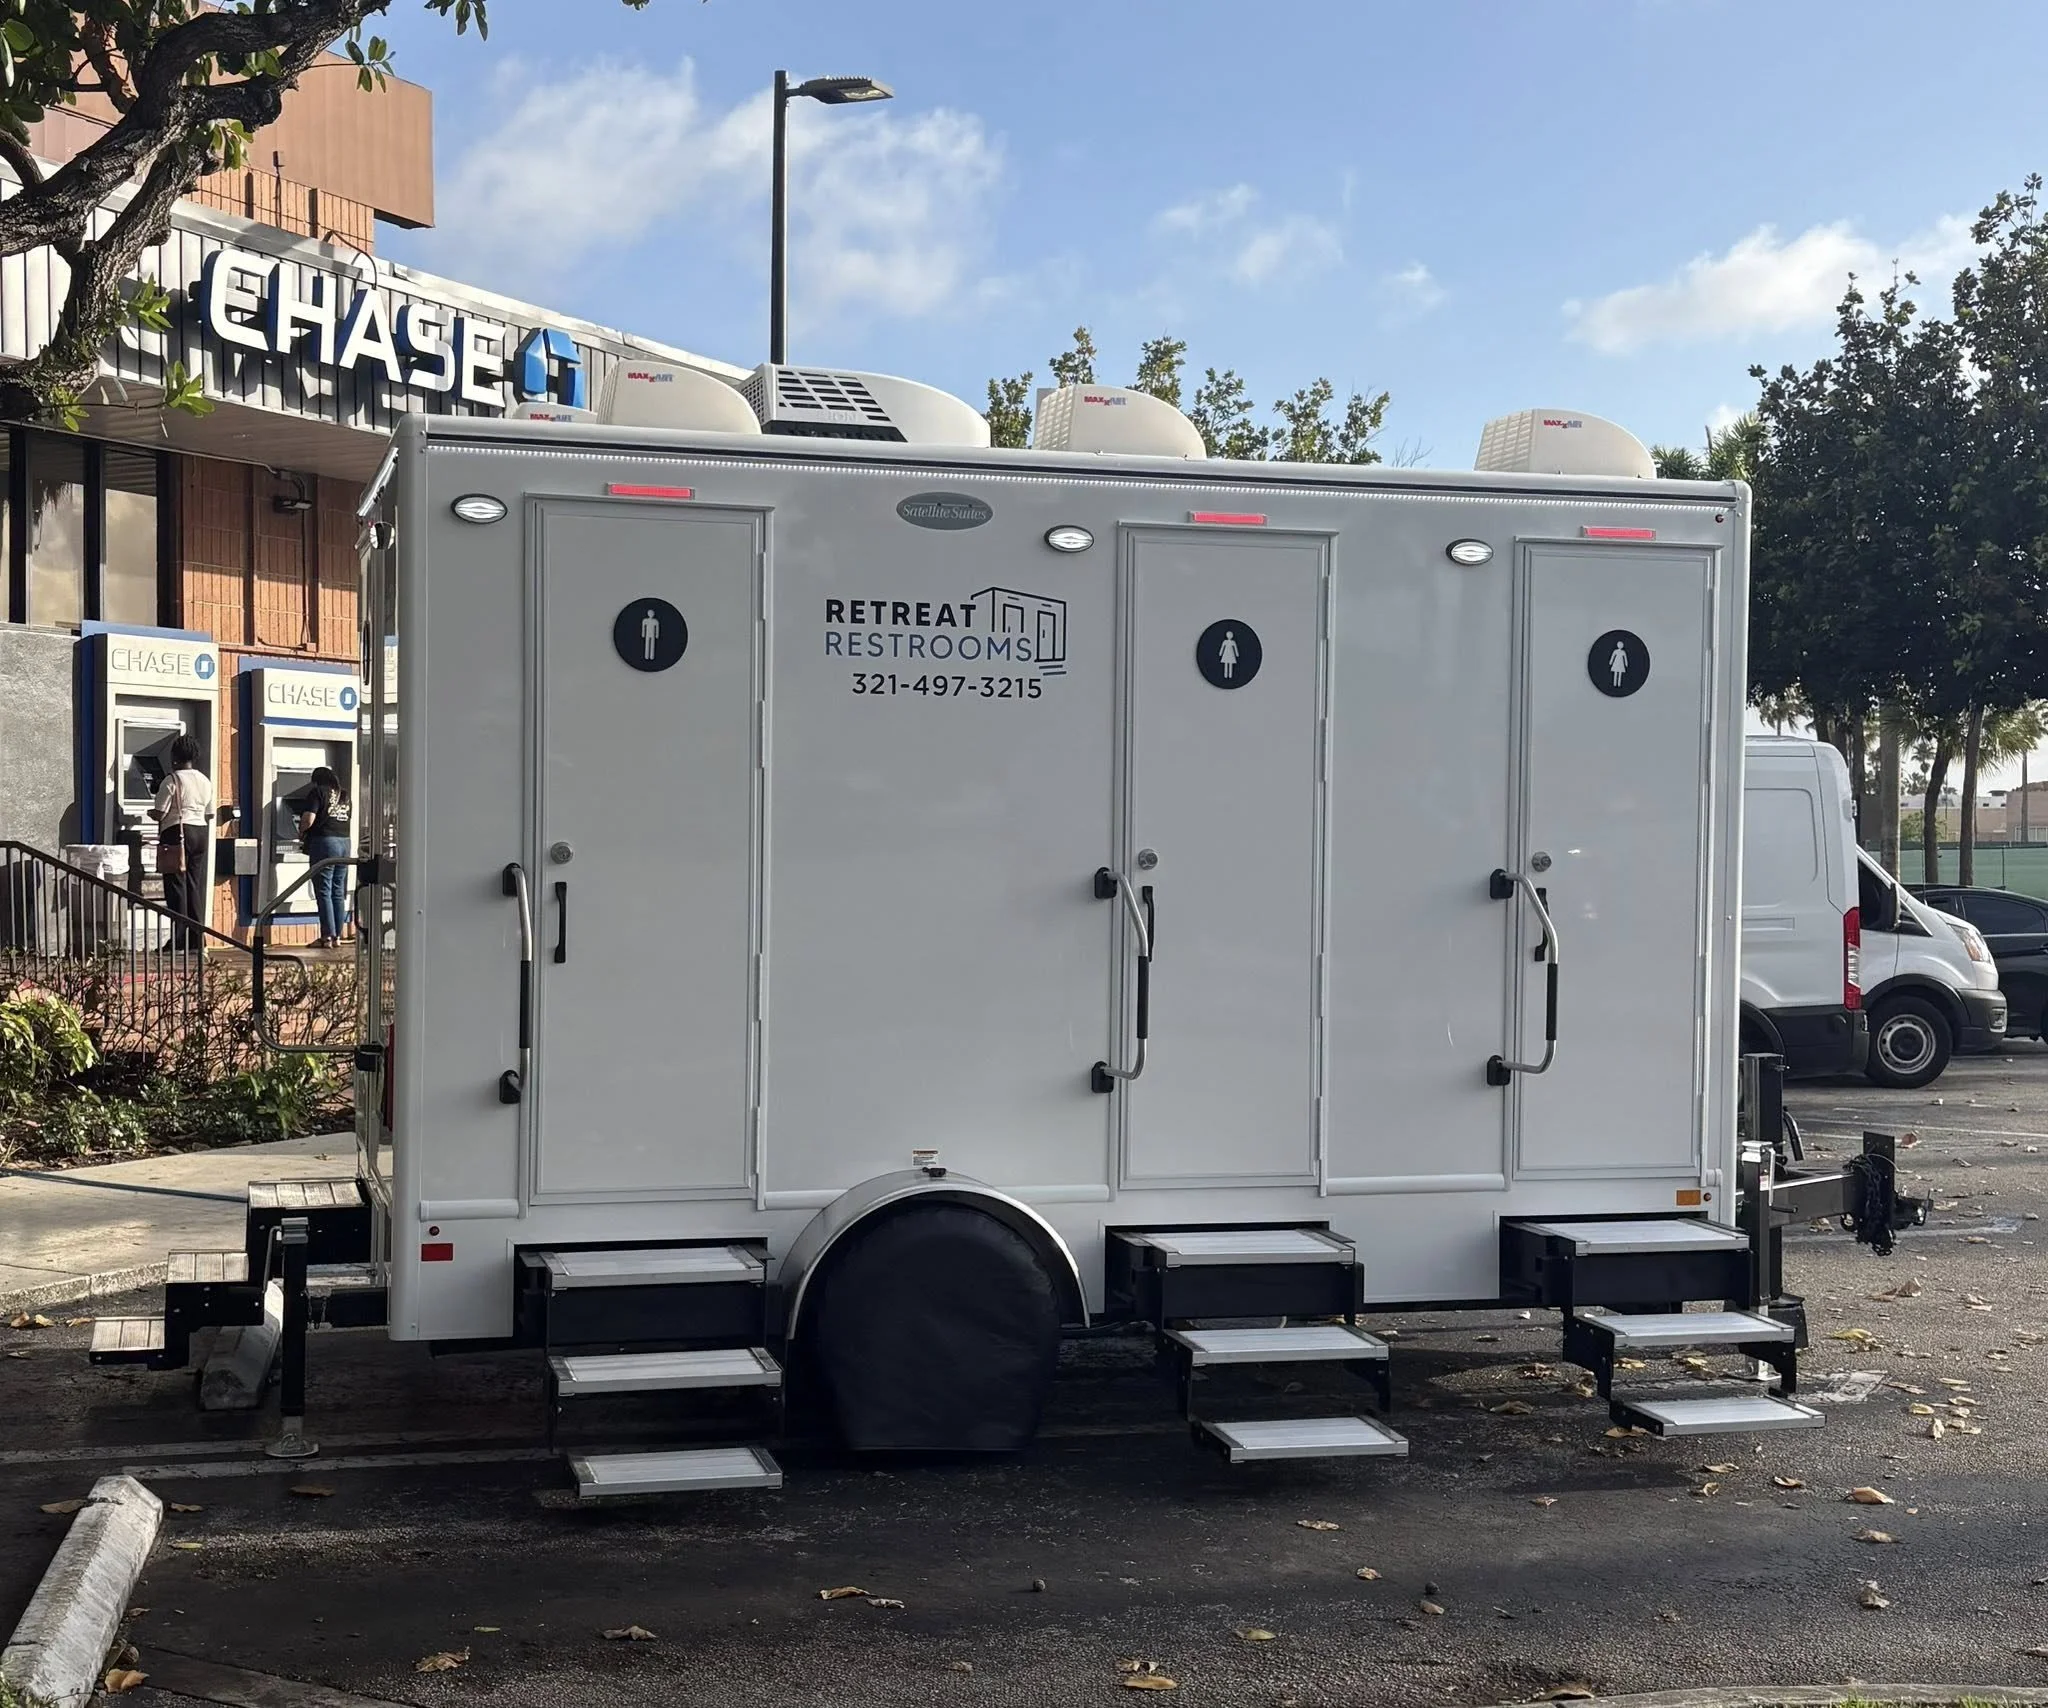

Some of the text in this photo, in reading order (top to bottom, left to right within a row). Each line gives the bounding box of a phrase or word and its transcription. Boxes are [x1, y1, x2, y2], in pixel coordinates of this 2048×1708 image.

[208, 248, 506, 408] CHASE
[902, 504, 987, 520] Satellite Suites
[826, 599, 977, 628] RETREAT
[825, 631, 1033, 662] RESTROOMS
[111, 648, 192, 676] CHASE
[268, 682, 337, 708] CHASE
[852, 673, 1043, 699] 321-497-3215
